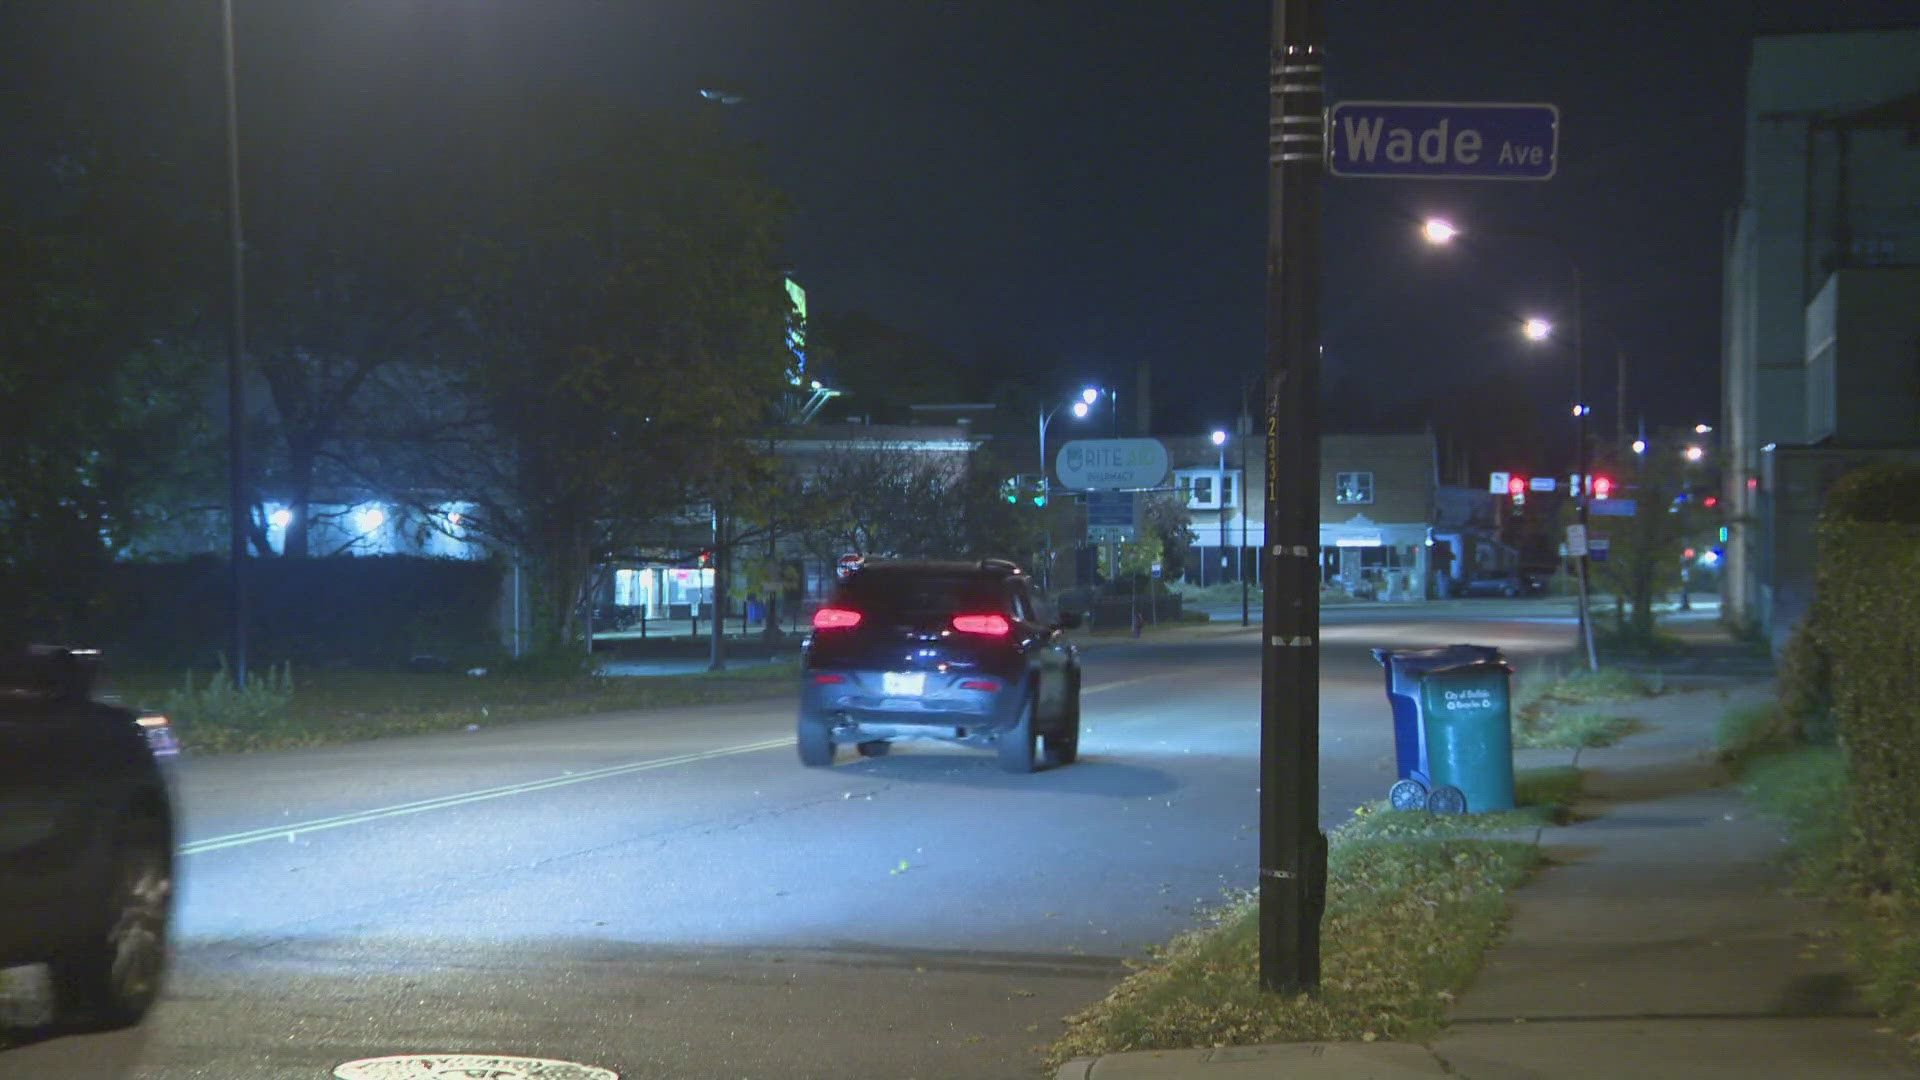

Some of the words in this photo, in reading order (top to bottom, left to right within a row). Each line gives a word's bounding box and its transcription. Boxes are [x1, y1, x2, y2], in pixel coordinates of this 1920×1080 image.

[1344, 117, 1483, 164] Wade
[1498, 141, 1544, 166] Ave
[1085, 447, 1122, 467] RITE
[1128, 447, 1157, 467] AID
